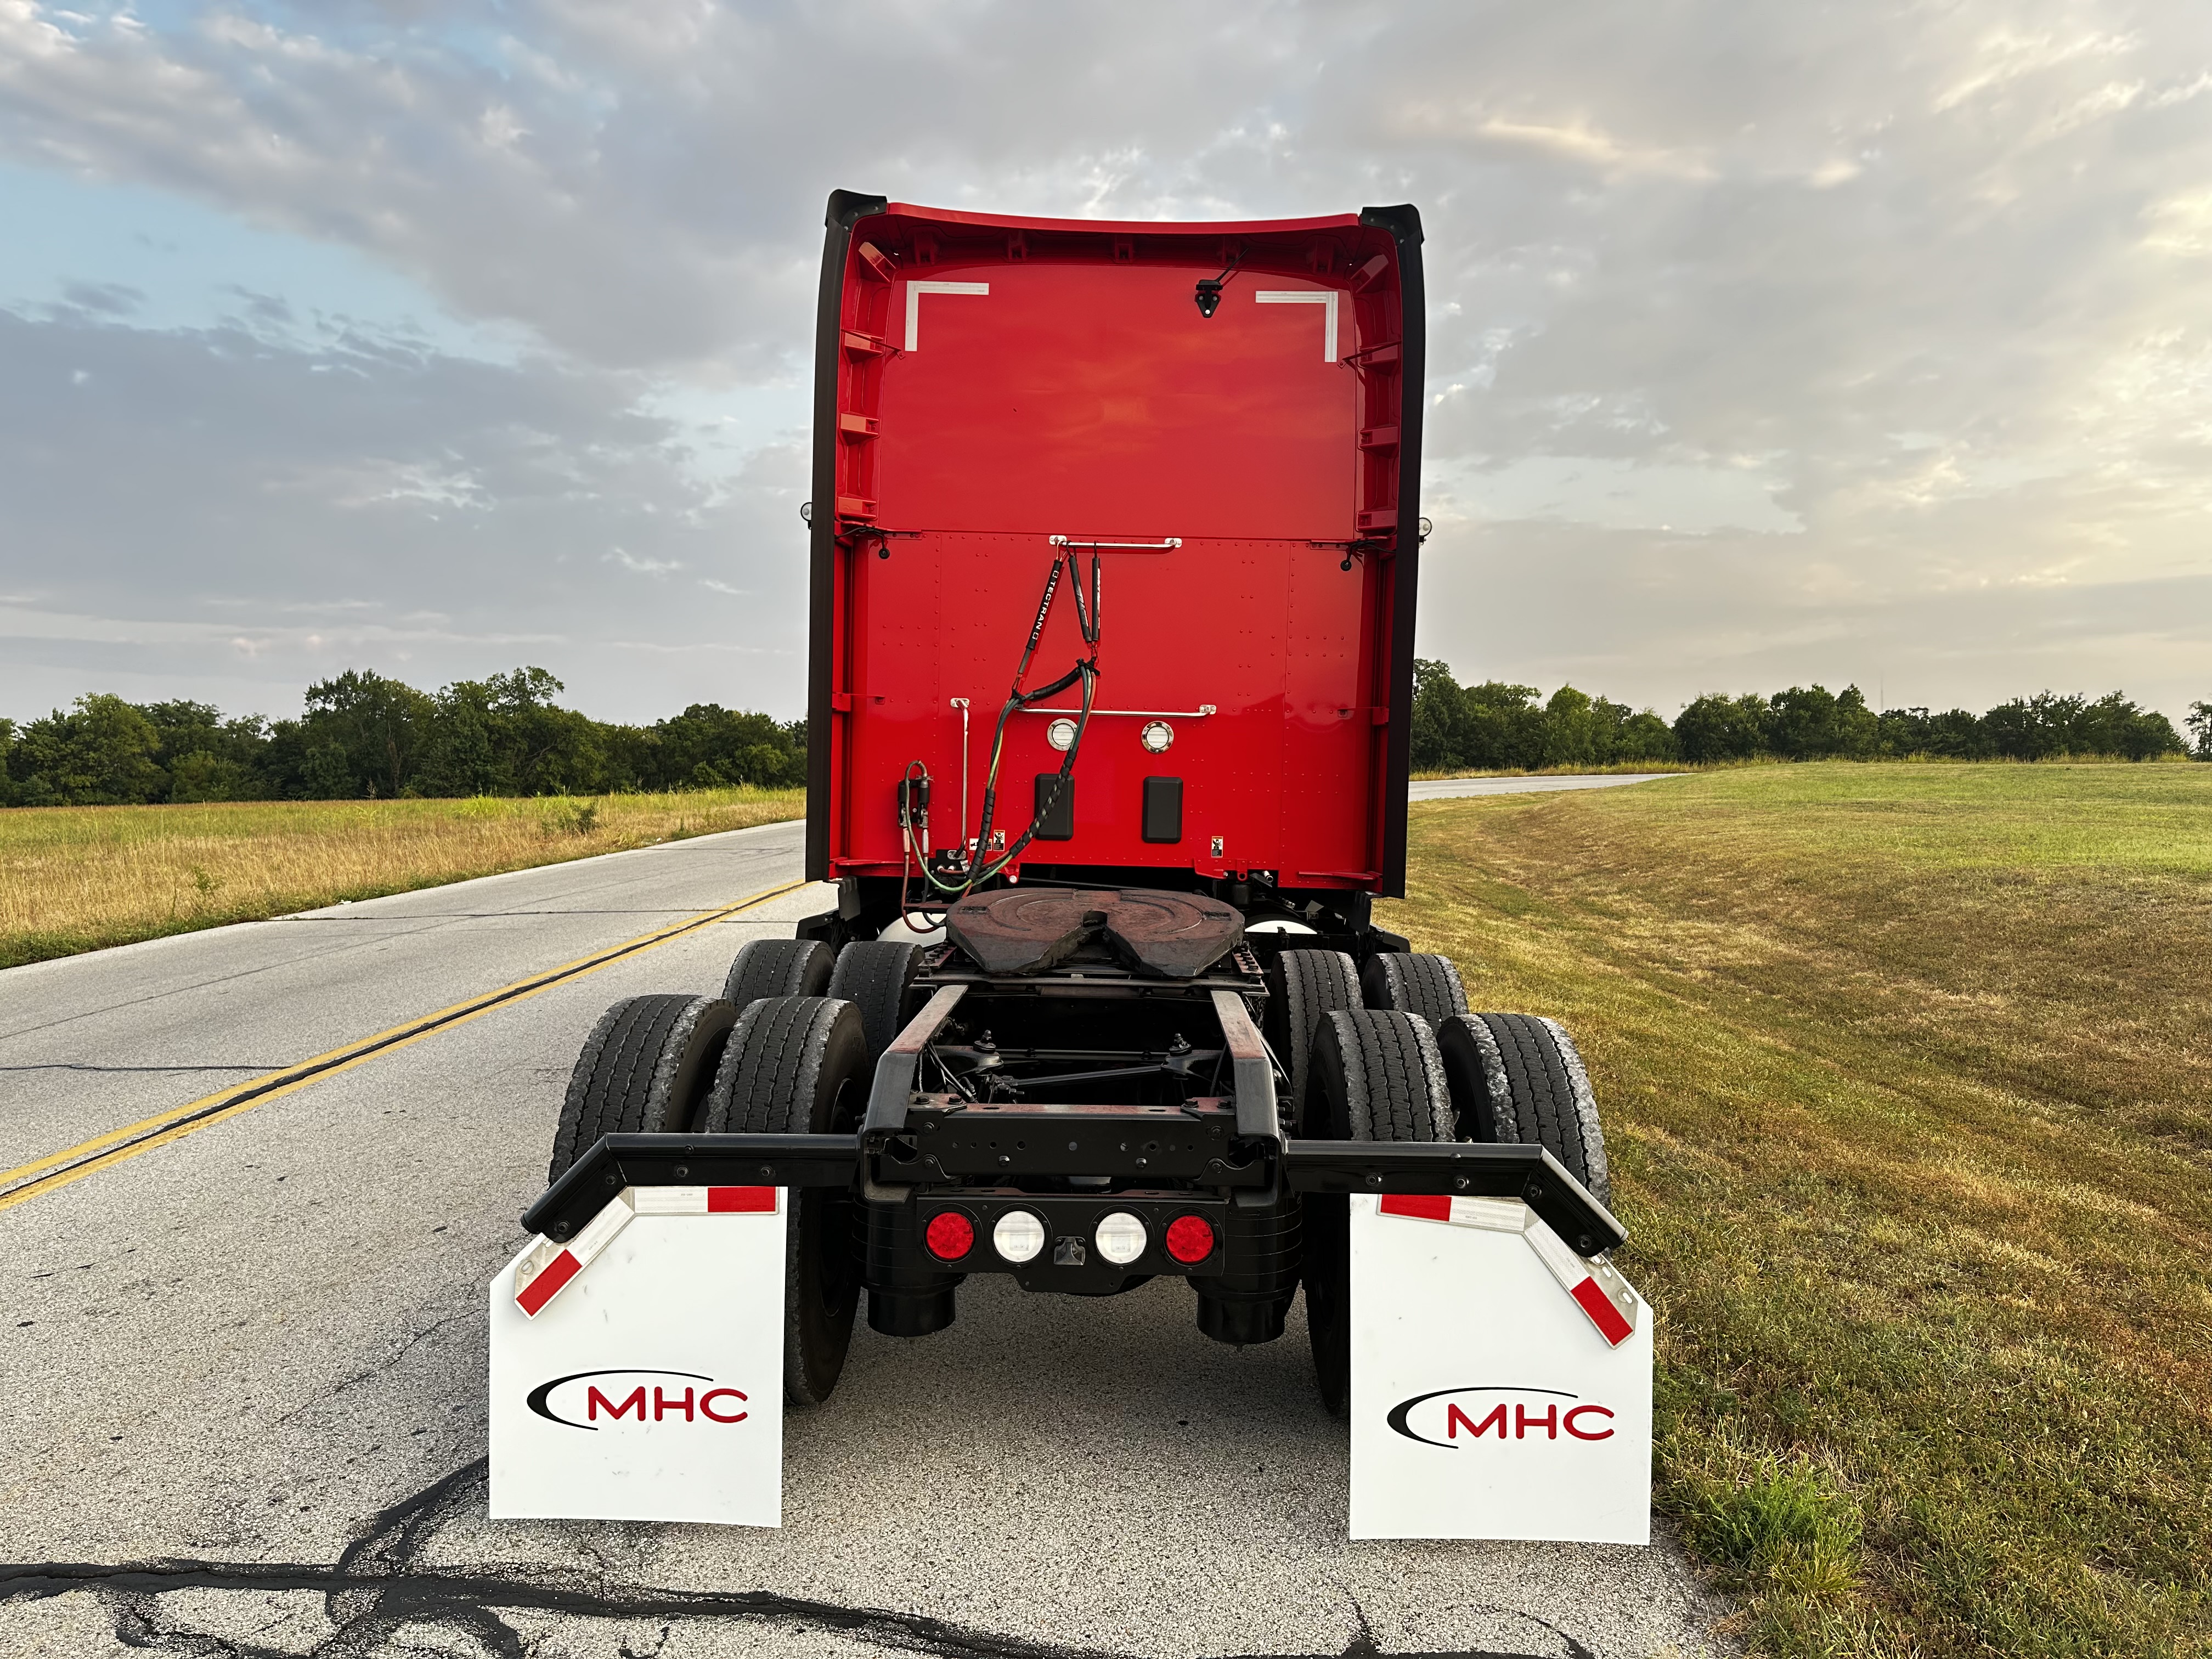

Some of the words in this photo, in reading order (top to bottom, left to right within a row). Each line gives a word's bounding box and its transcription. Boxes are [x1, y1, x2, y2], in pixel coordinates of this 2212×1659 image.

[1036, 581, 1056, 630] TECTRAN
[588, 1386, 748, 1423] MHC
[1448, 1403, 1615, 1441] MHC
